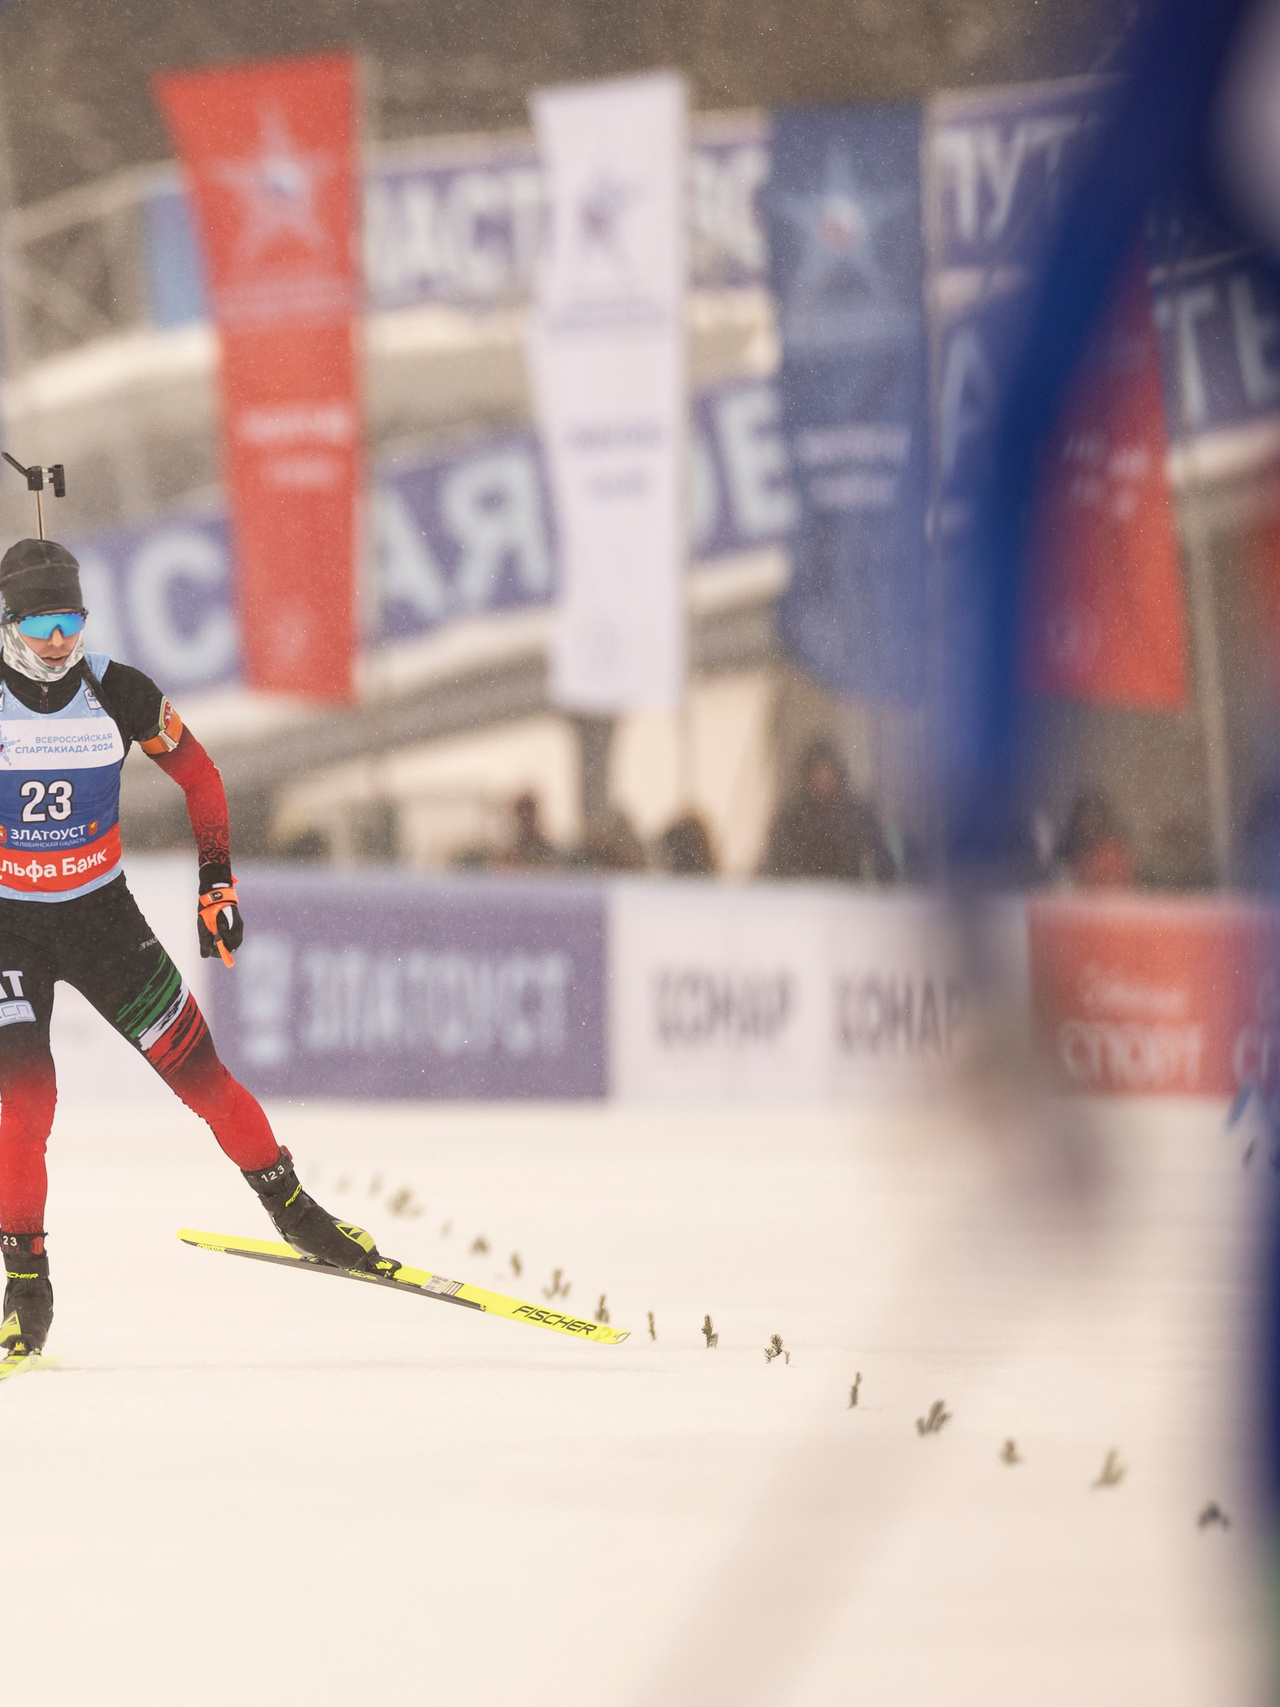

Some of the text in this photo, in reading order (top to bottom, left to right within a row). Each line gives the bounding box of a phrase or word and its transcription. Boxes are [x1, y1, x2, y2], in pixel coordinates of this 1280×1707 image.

[35, 732, 113, 744] ВСЕРОССИЙСКАЯ
[15, 743, 114, 755] СПАРТАКИАДА 2024
[20, 780, 74, 822] 23
[10, 825, 86, 841] ЗЛАТОУСТ
[62, 848, 107, 876] Банк
[261, 1164, 285, 1183] 123
[3, 1235, 17, 1247] 23
[512, 1305, 598, 1336] FISCHER
